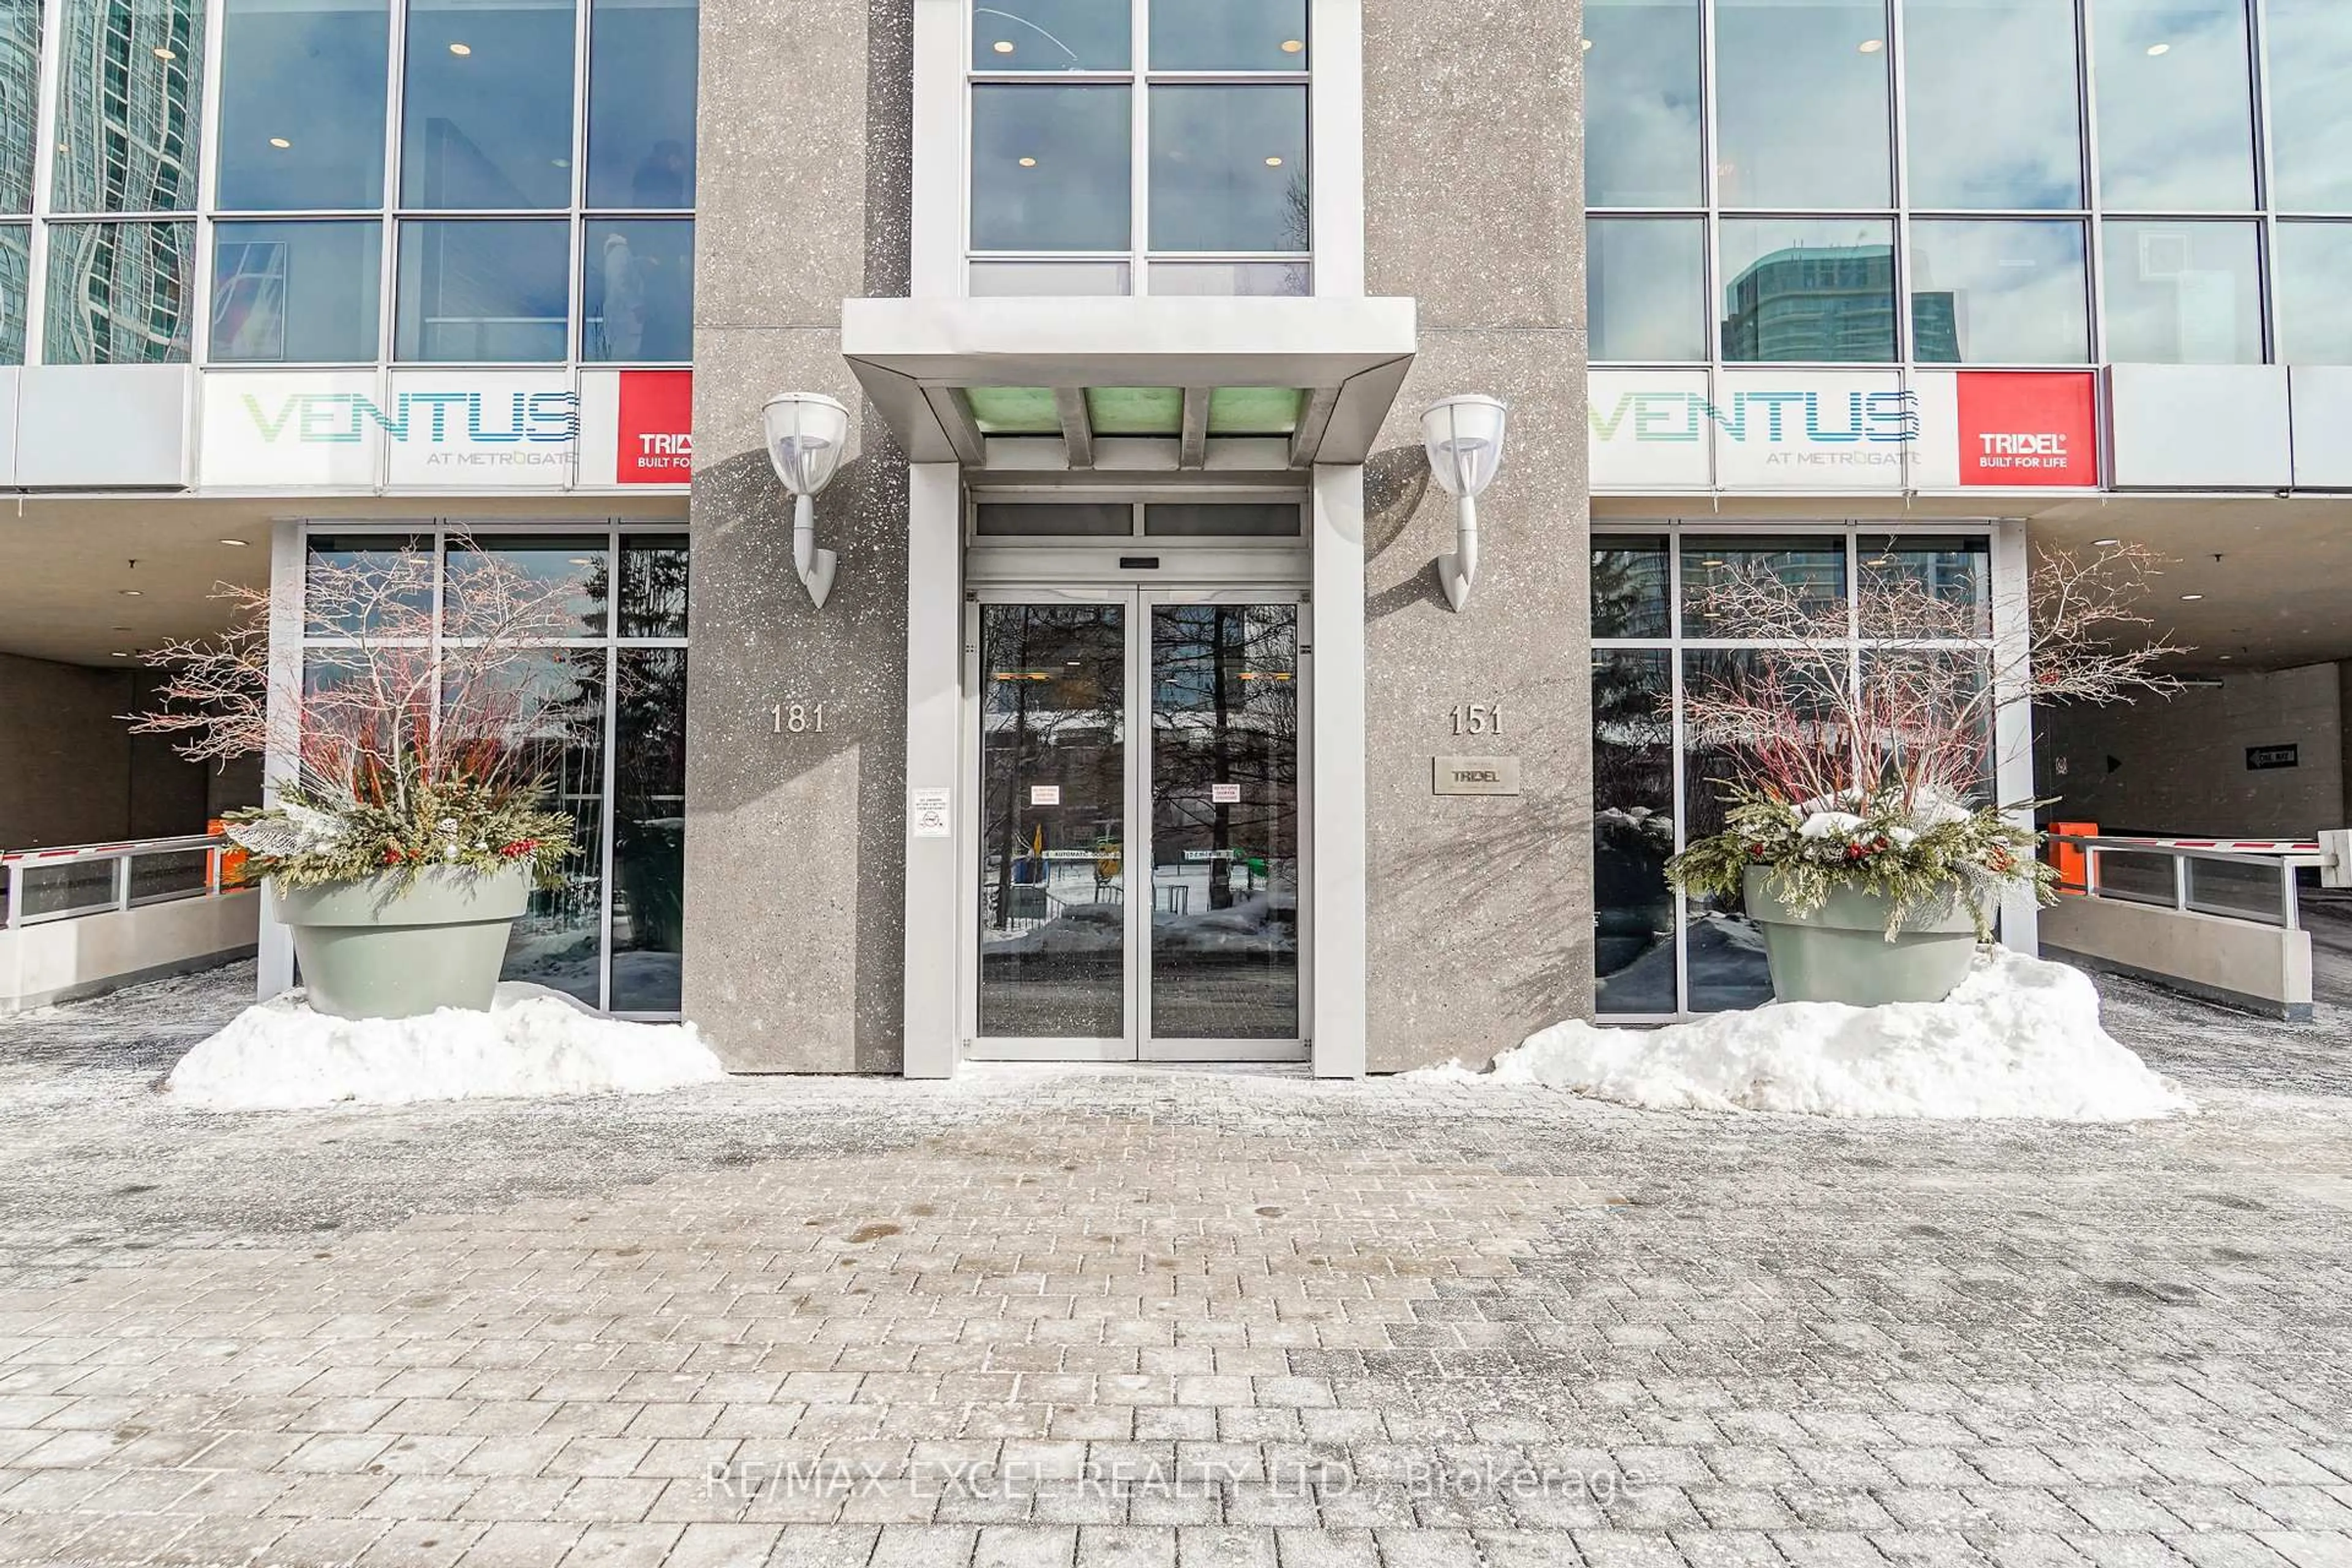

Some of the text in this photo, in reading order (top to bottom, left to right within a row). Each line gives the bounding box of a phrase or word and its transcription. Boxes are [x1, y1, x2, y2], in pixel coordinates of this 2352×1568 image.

[241, 391, 579, 442] VENTUS
[1588, 390, 1920, 442] VENTUS
[639, 433, 692, 454] TRID
[1980, 433, 2067, 454] TRIDEL
[427, 452, 453, 465] AT
[638, 457, 690, 467] BUILT FO
[1766, 452, 1793, 465] AT
[1980, 457, 2067, 467] BUILT FOR LIFE
[771, 704, 823, 733] 181
[1450, 704, 1502, 735] 151
[1451, 770, 1501, 783] TRIDEL
